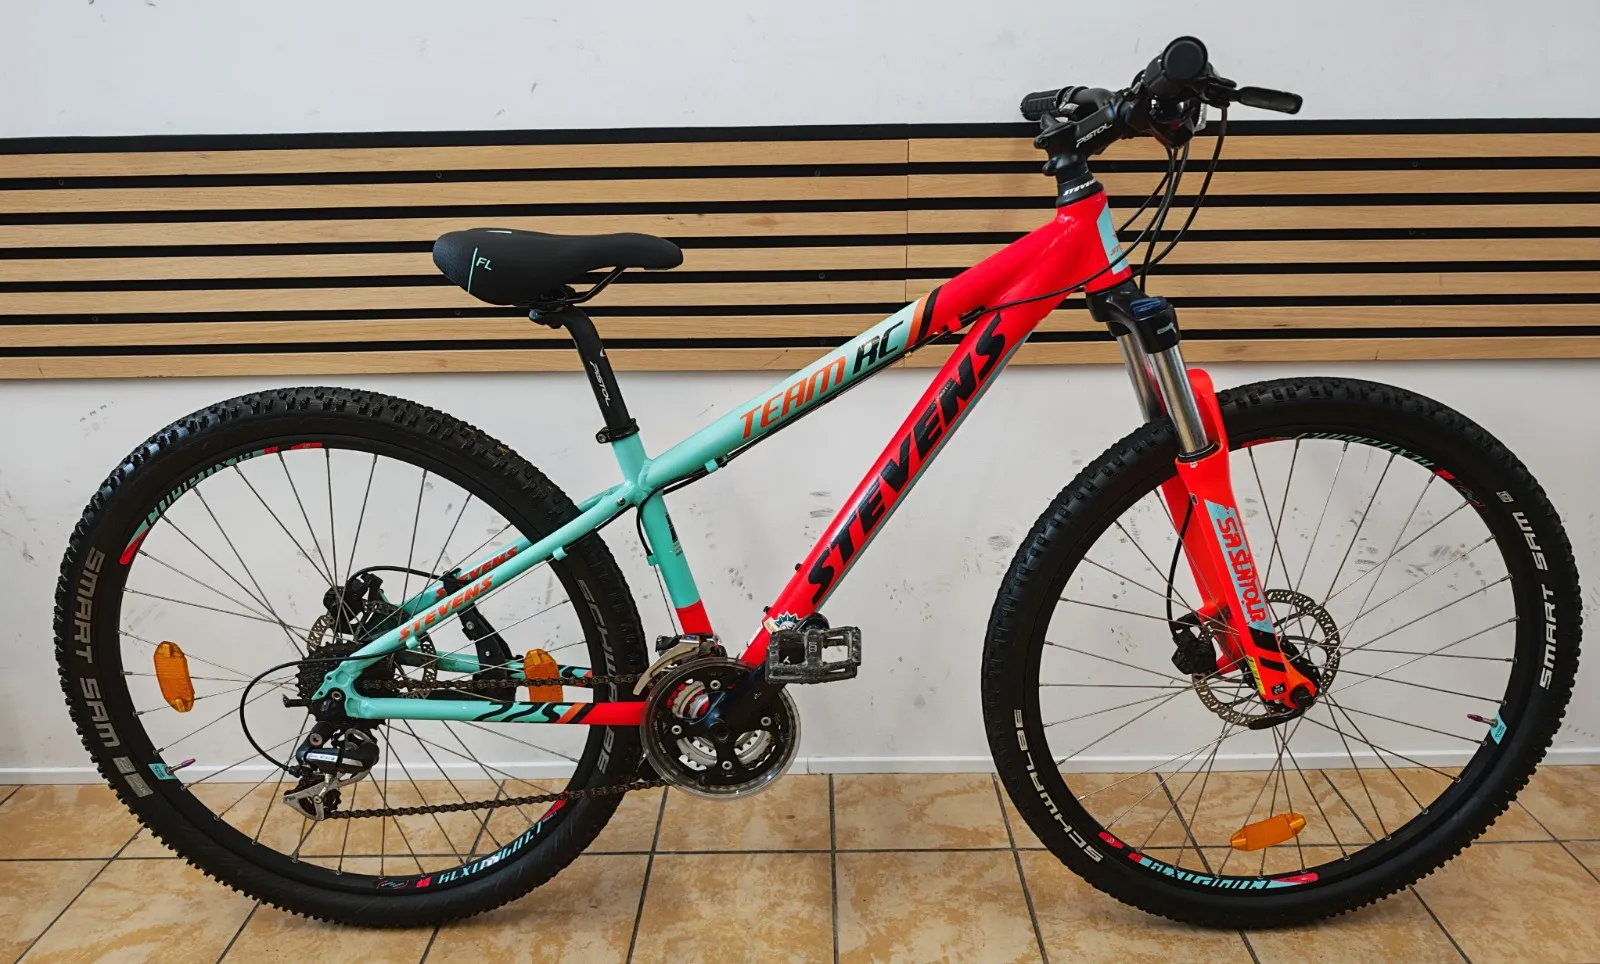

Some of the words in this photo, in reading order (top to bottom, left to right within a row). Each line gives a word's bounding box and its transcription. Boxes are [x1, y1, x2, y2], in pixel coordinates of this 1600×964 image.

[1075, 123, 1113, 149] PISTOL
[475, 256, 492, 271] FL
[739, 355, 847, 440] TEAM
[852, 320, 905, 375] RC
[807, 311, 1006, 605] STEVENS
[1511, 511, 1549, 571] SAM
[74, 546, 106, 664] SMART
[398, 574, 494, 643] STEVENS
[1539, 584, 1558, 691] SMART
[79, 677, 121, 749] SAM
[577, 578, 618, 775] SCHWABE
[1013, 708, 1104, 864] SCHWALBE
